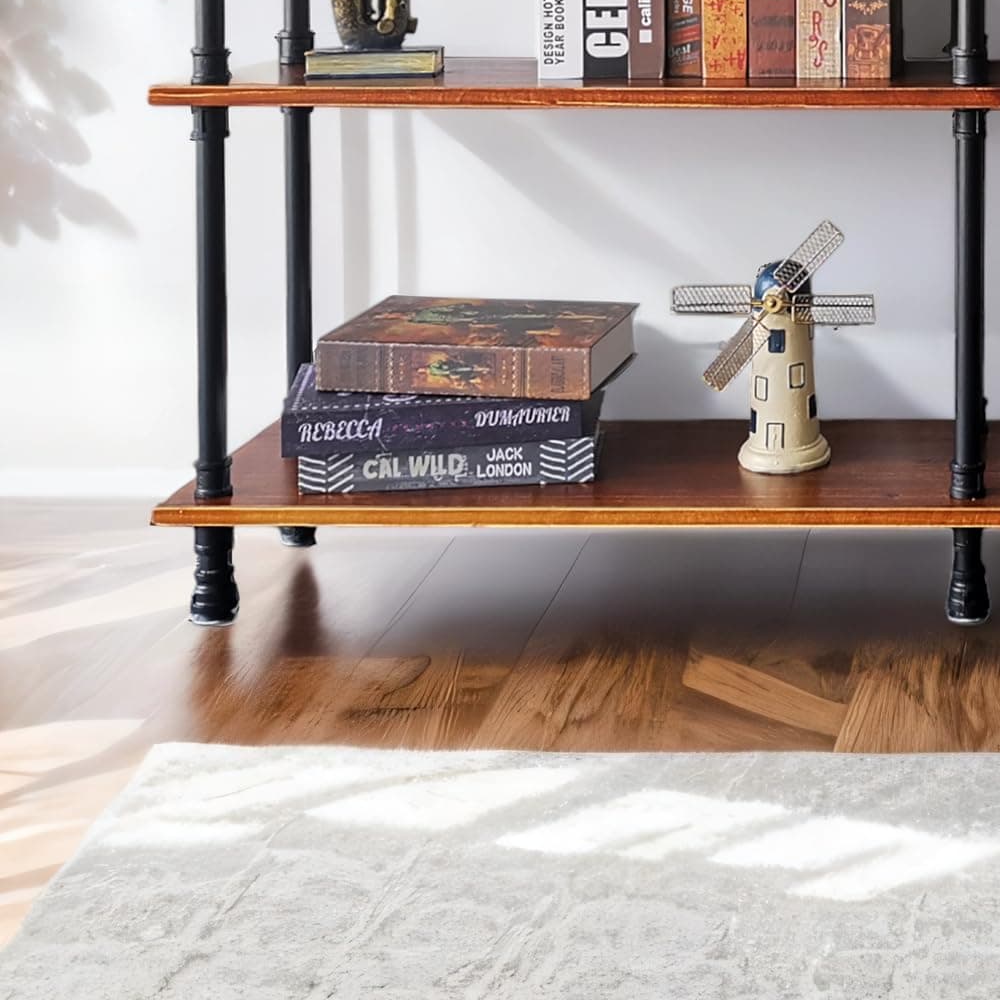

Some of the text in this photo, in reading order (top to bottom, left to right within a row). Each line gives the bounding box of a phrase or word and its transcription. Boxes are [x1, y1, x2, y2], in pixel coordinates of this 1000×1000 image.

[543, 22, 554, 65] DESIGN
[554, 34, 565, 65] YEAR
[474, 405, 570, 428] DUMAURIER
[299, 417, 382, 442] REBECCA
[486, 446, 523, 462] JACK
[476, 461, 532, 479] LONDON
